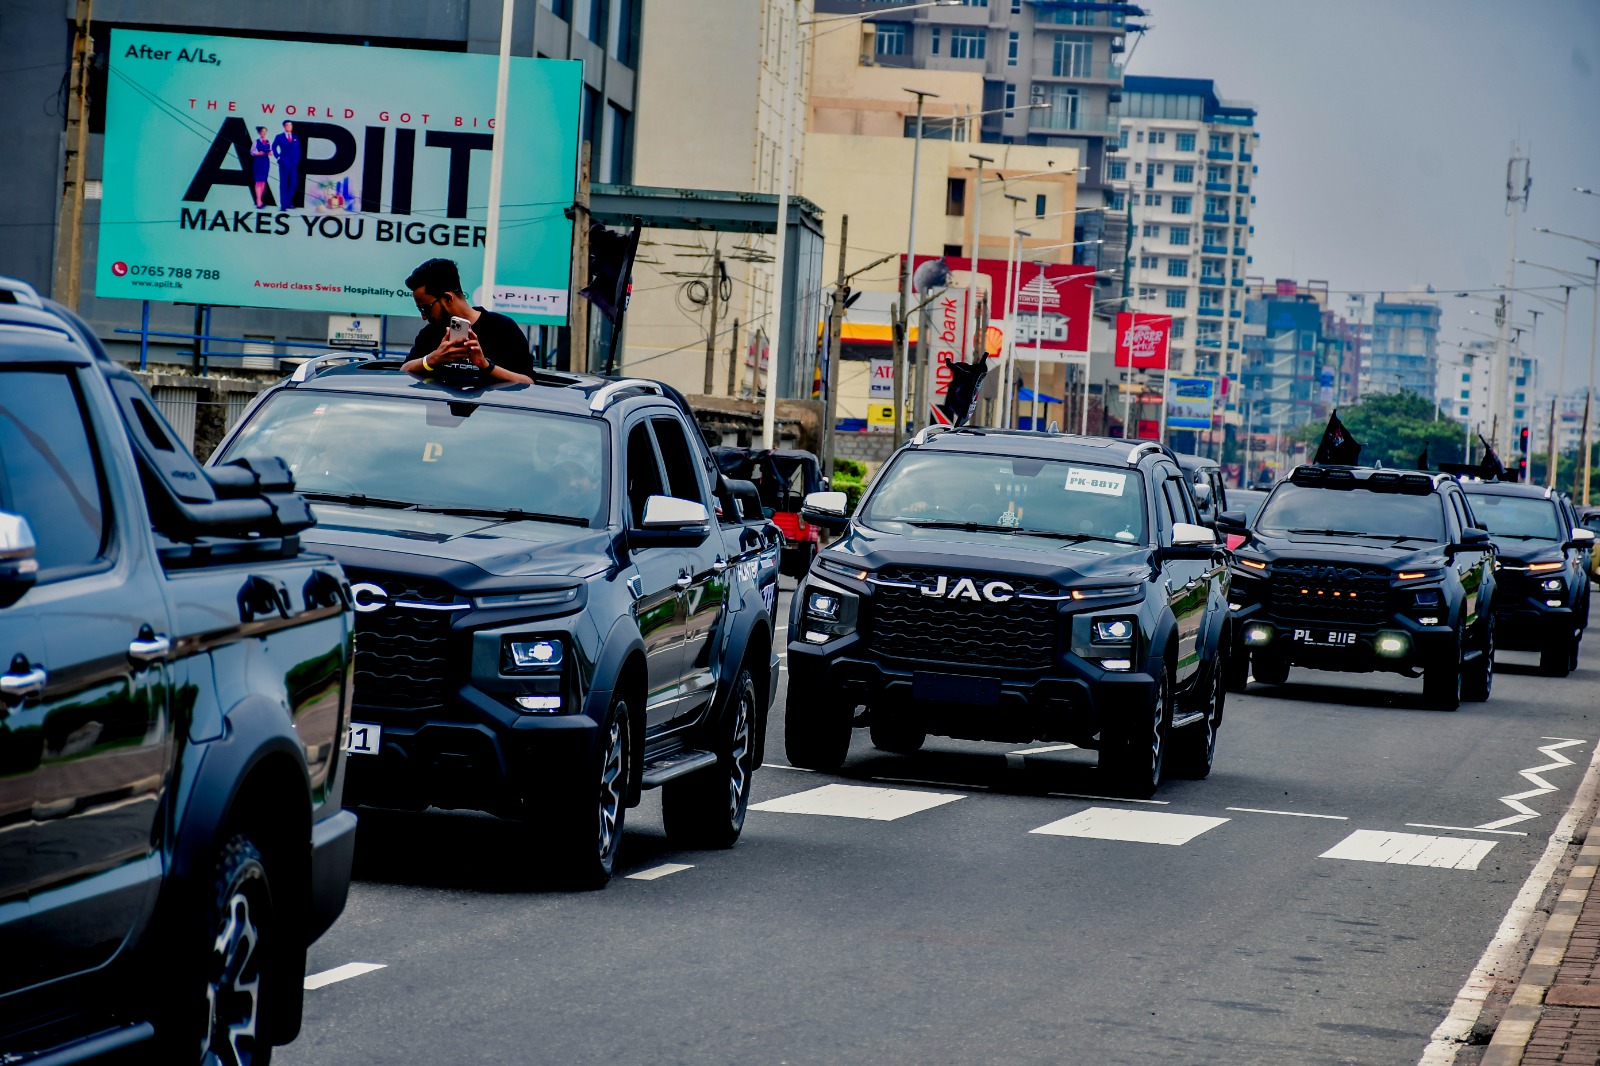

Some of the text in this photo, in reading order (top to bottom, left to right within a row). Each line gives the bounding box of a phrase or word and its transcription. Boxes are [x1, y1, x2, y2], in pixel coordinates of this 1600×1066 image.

[125, 44, 222, 66] After A/Ls,
[188, 99, 495, 129] THE WORLD GOT BIG
[181, 116, 494, 219] APIIT
[180, 208, 487, 248] MAKES YOU BIGGER
[130, 265, 220, 281] 0765 788 788
[131, 280, 183, 290] www.apiit.lk
[263, 281, 288, 289] world
[291, 282, 313, 291] class
[316, 283, 342, 293] Swiss
[344, 285, 394, 298] Hospitality
[935, 297, 957, 395] NDB bank
[1070, 477, 1120, 490] PK-8817
[920, 575, 1015, 603] JAC
[1293, 629, 1357, 644] PL 2112
